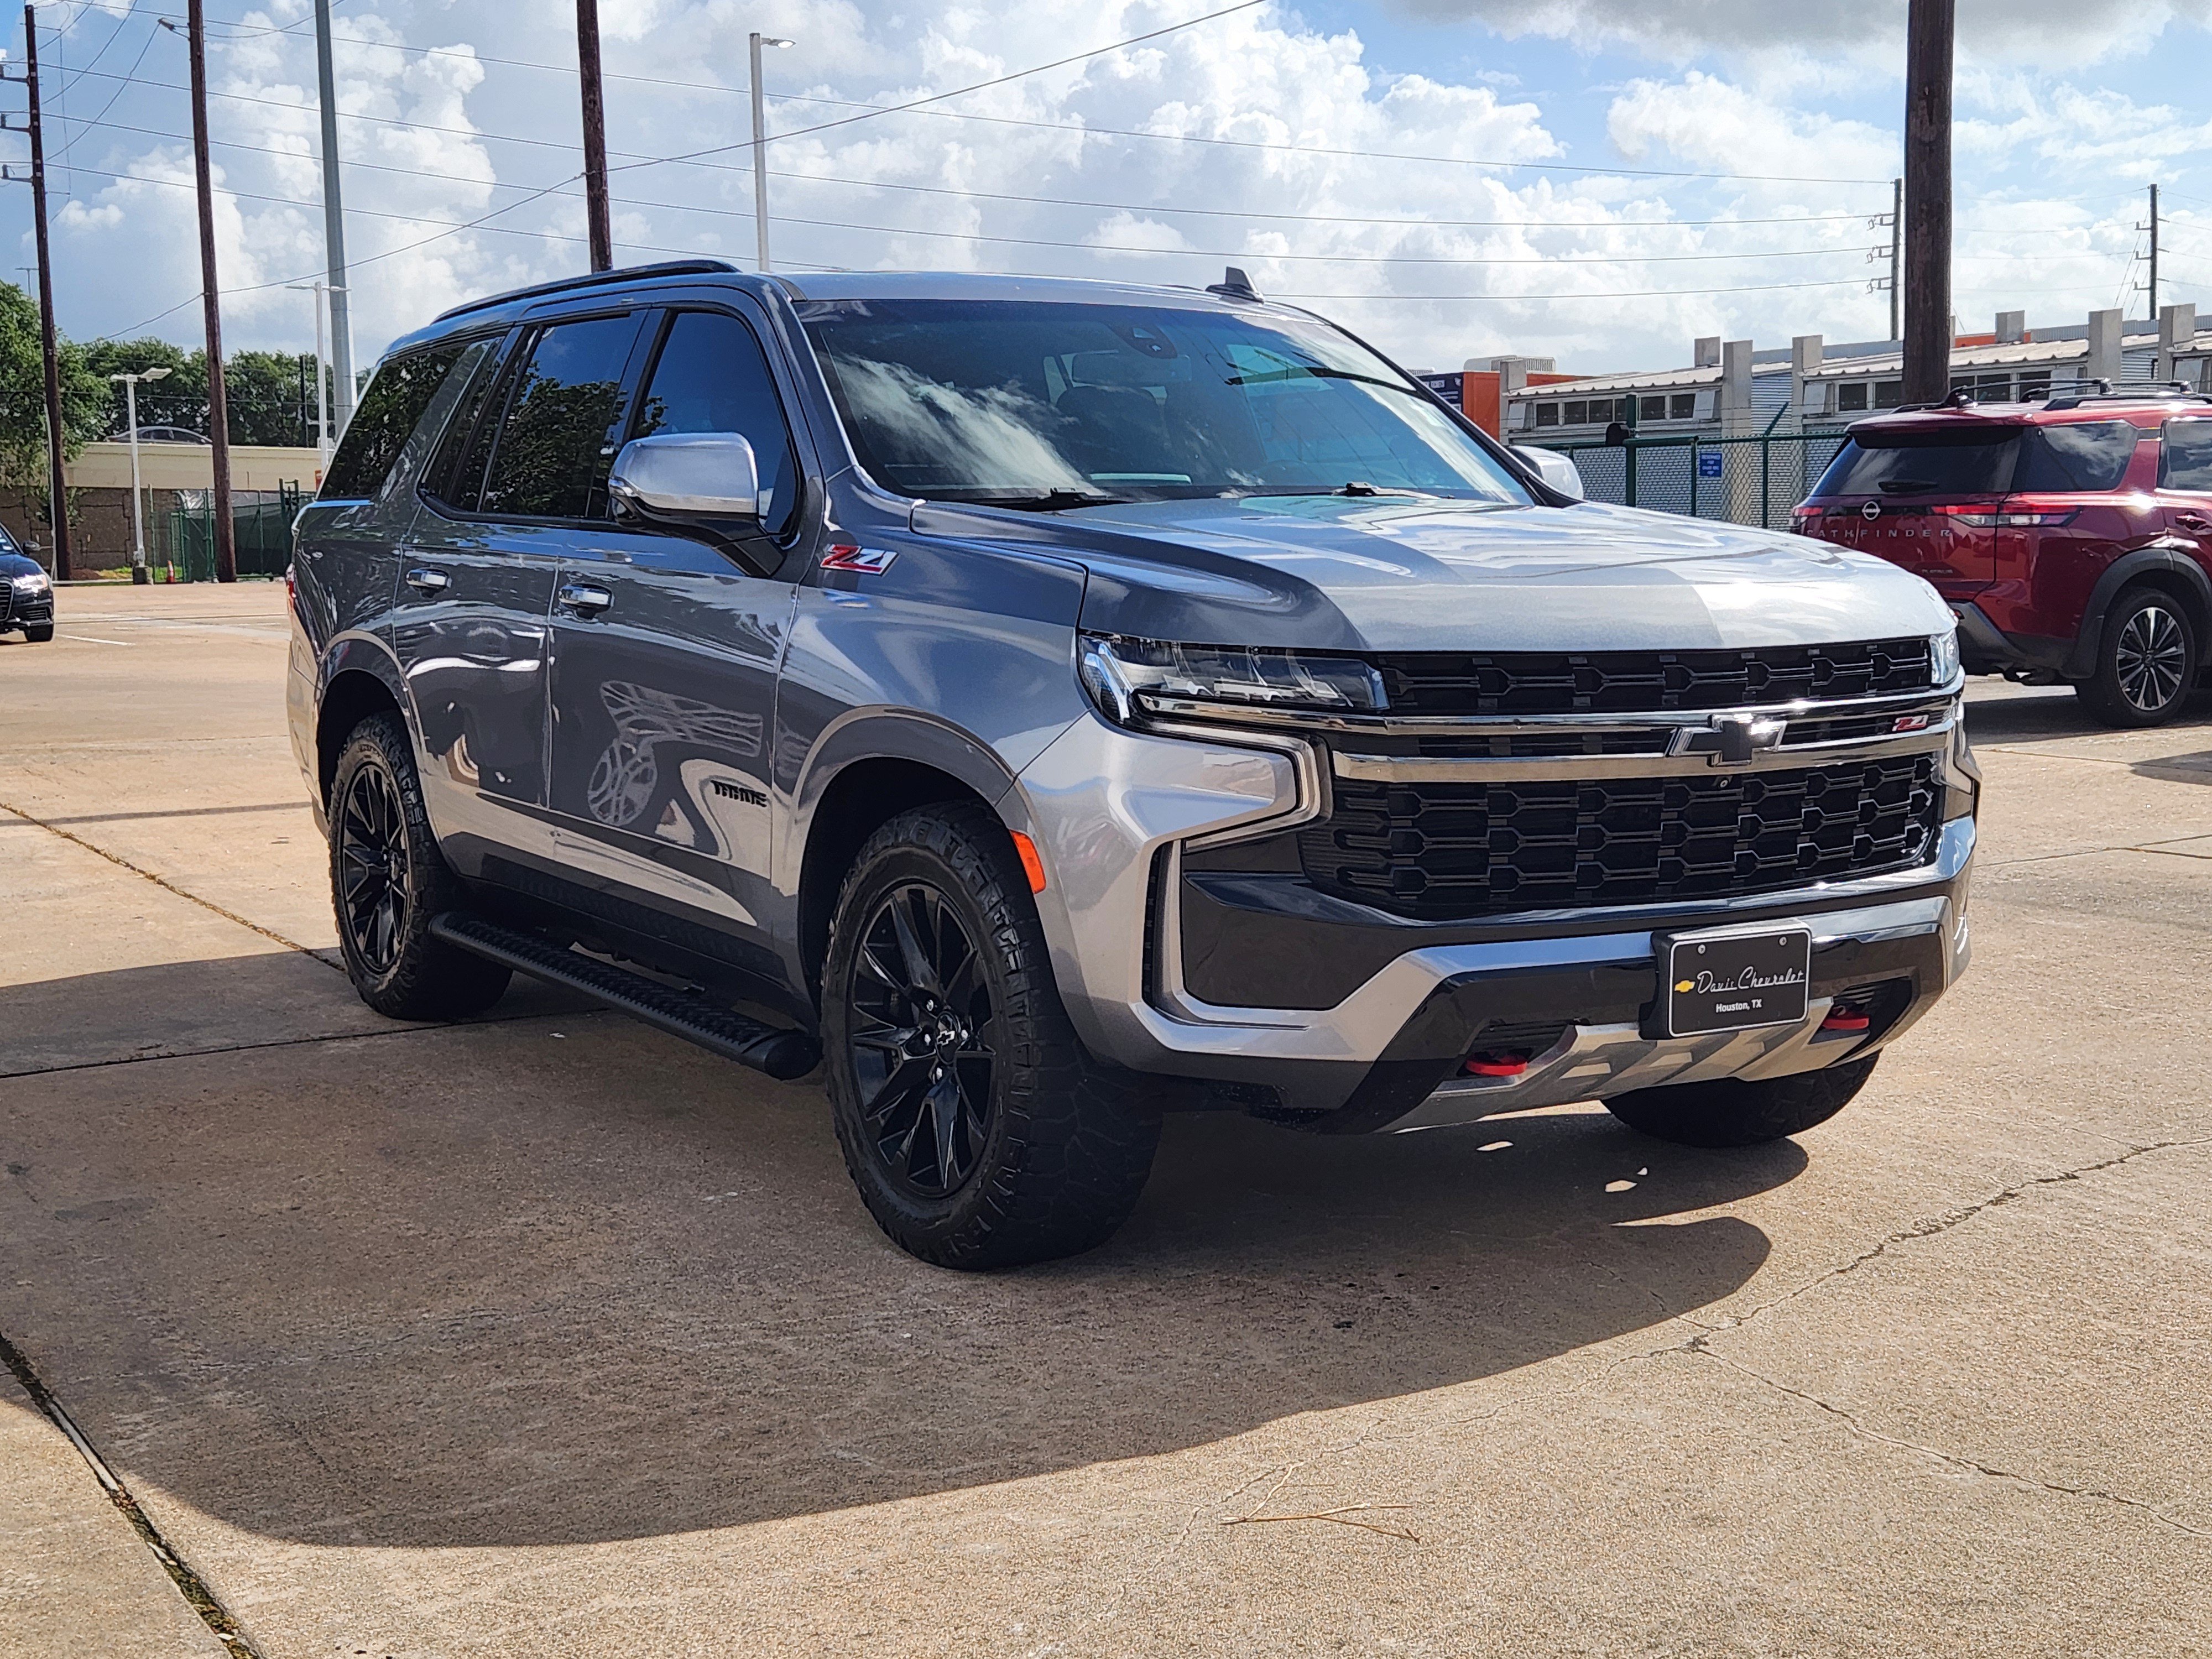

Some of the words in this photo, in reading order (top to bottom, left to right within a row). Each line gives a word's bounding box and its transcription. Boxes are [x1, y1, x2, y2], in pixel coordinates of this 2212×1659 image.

[1807, 529, 1950, 538] PATHFINDER
[820, 544, 898, 575] Z71
[1892, 714, 1929, 732] Z71
[1738, 966, 1805, 991] Chevrolet
[1716, 1003, 1750, 1013] Houston,
[1751, 999, 1762, 1009] TX
